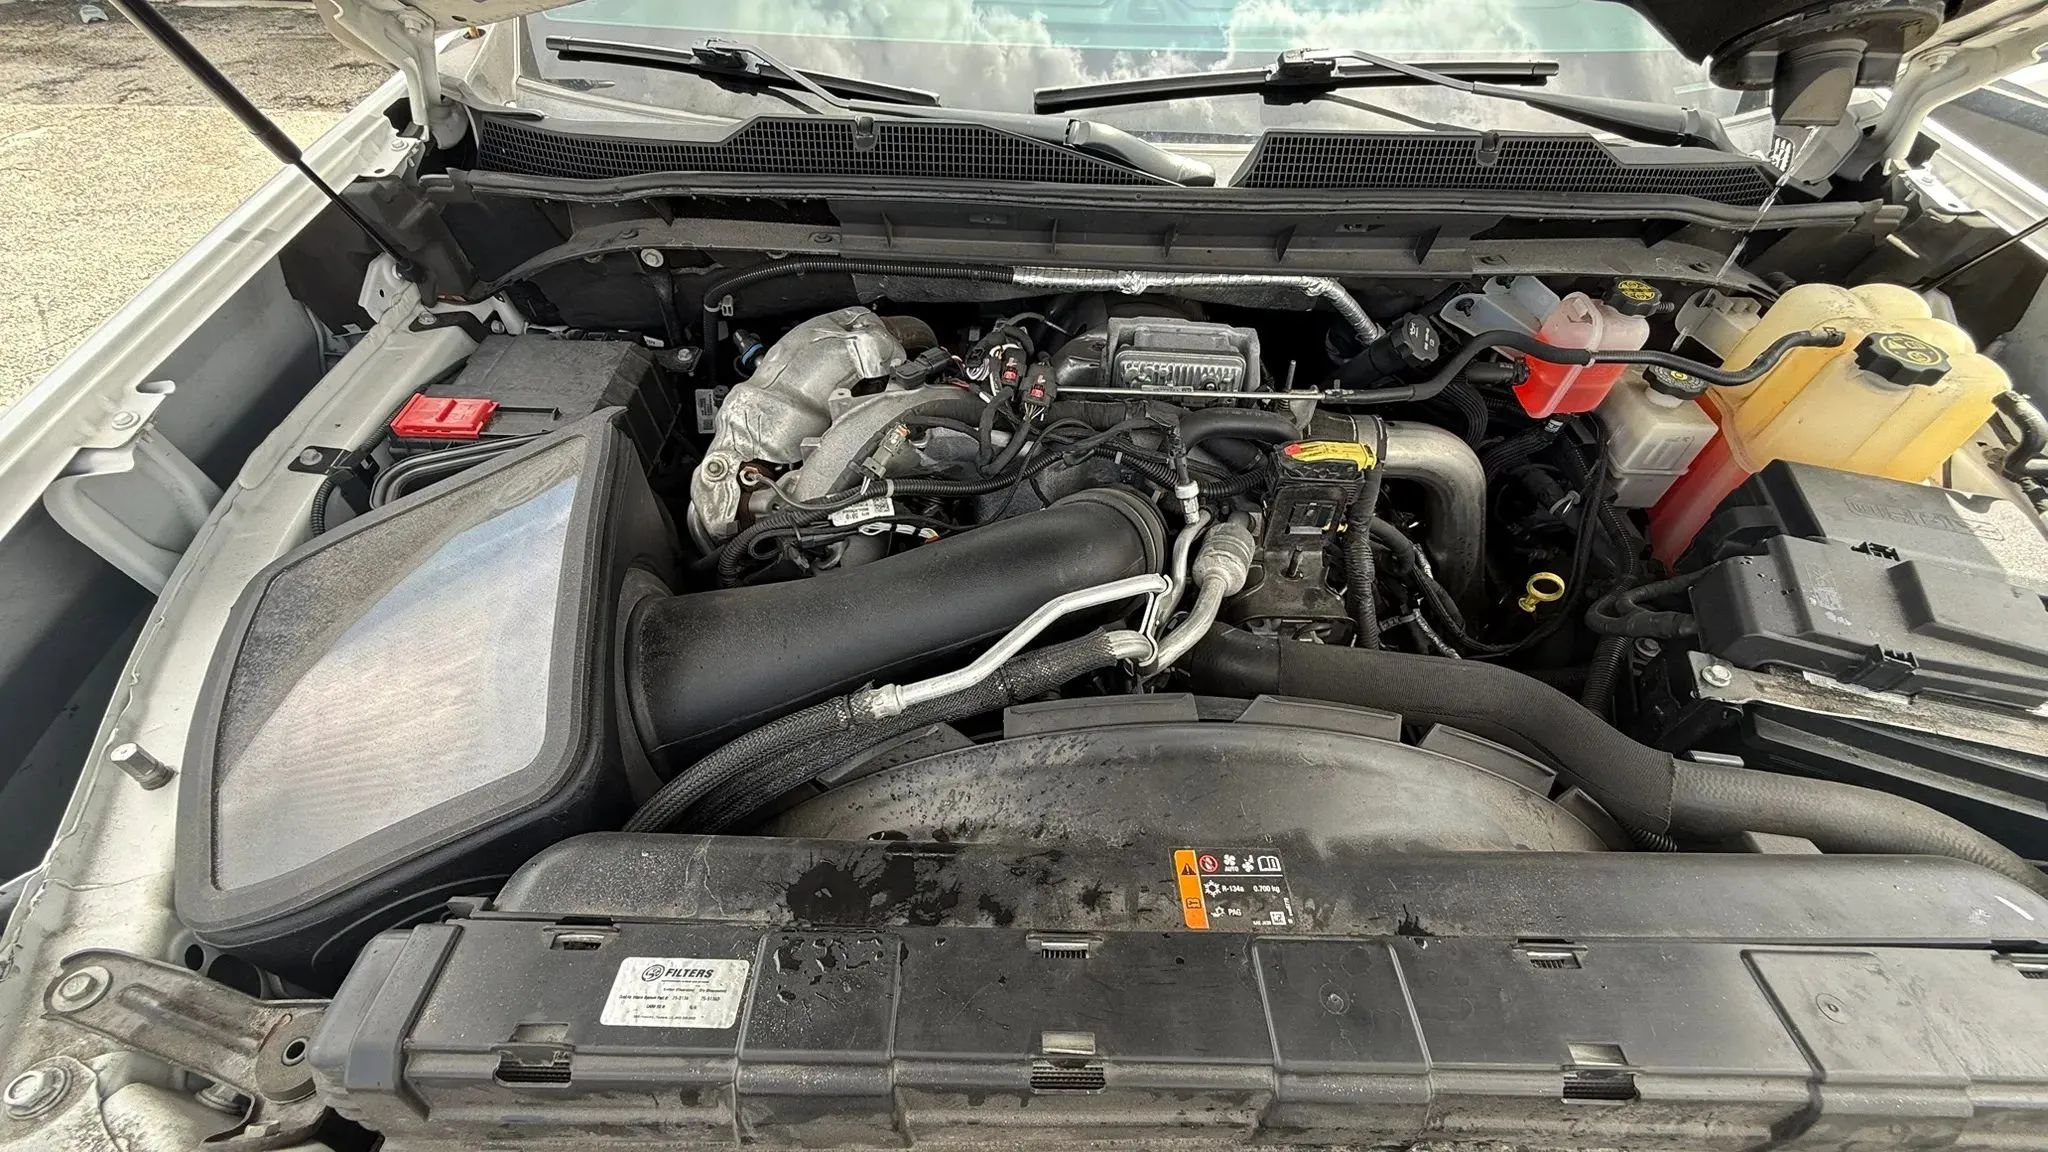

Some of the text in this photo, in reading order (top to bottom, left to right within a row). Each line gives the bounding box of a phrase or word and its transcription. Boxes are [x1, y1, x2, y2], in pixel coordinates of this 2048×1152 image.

[1222, 885, 1281, 894] R-134a 0.700 kg
[1227, 908, 1242, 917] PAG
[665, 968, 714, 978] FILTERS
